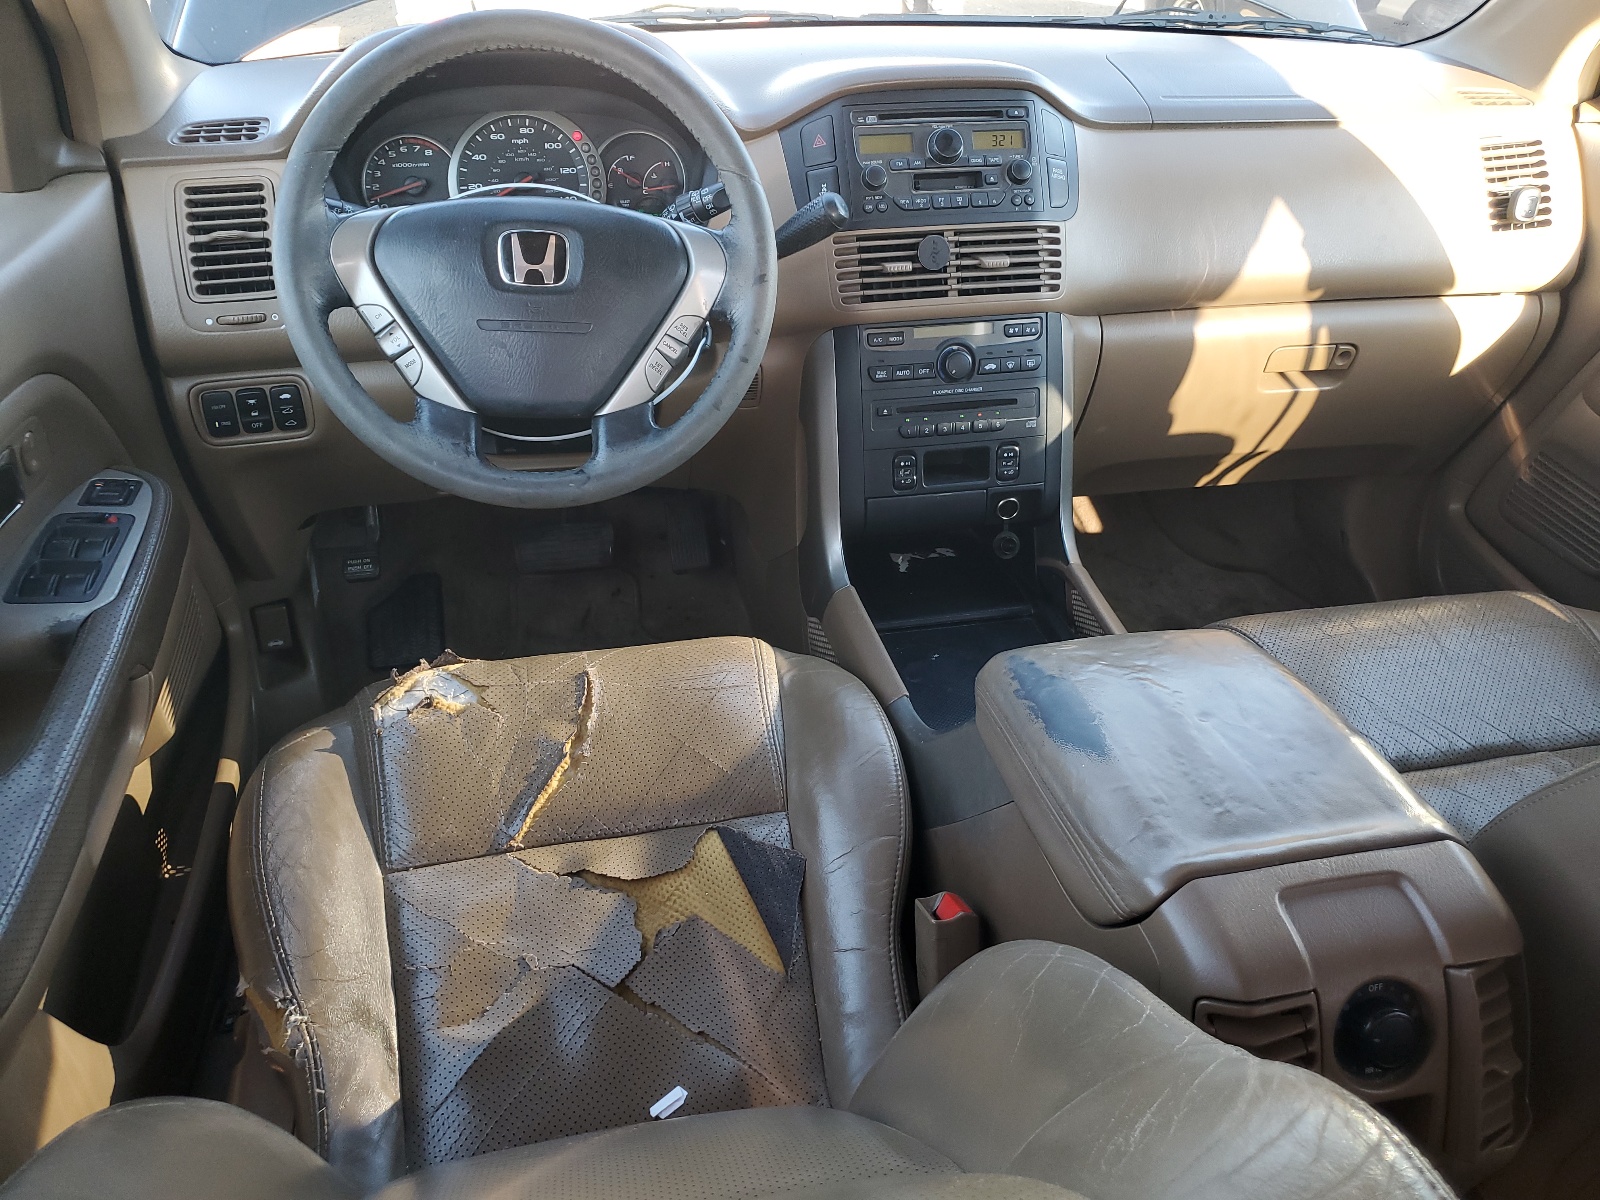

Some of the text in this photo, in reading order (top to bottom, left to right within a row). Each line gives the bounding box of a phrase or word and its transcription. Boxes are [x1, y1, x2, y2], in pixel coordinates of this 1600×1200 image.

[992, 134, 1013, 147] 321
[544, 142, 562, 150] 100
[388, 150, 396, 158] 5
[377, 158, 386, 166] 4
[560, 167, 577, 175] 120
[372, 183, 380, 191] 2
[374, 312, 383, 320] CH
[390, 335, 401, 344] VOL
[662, 340, 678, 355] CANCEL
[1368, 982, 1384, 992] OFF
